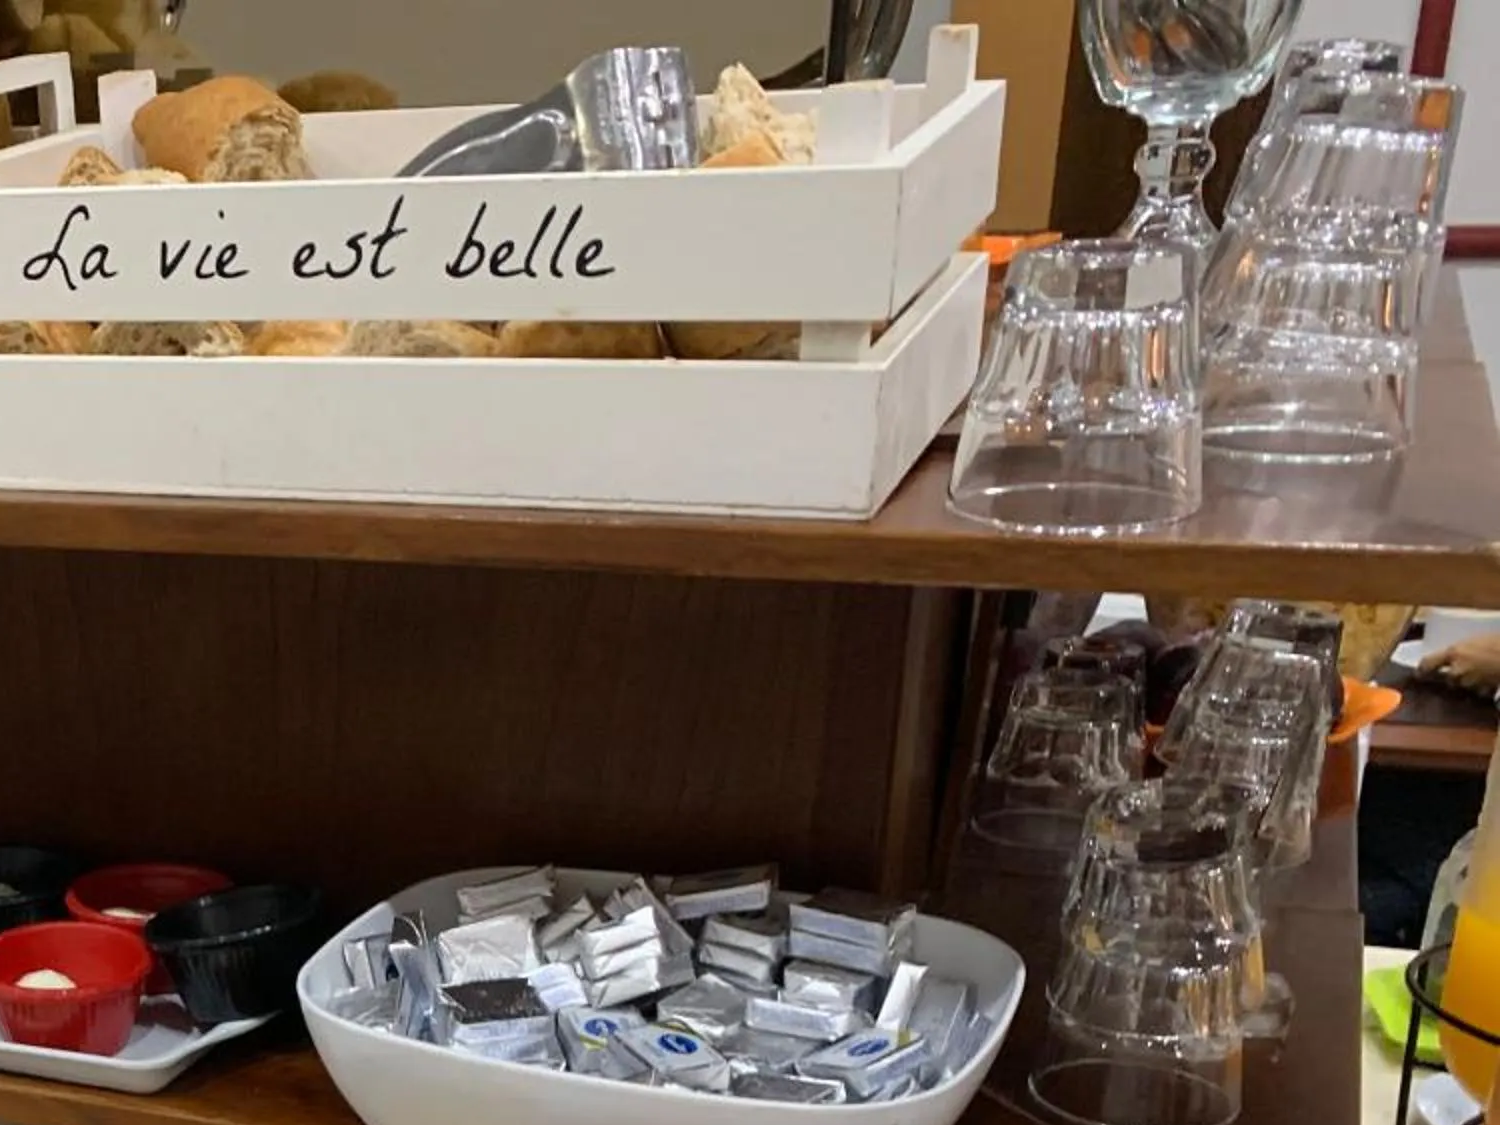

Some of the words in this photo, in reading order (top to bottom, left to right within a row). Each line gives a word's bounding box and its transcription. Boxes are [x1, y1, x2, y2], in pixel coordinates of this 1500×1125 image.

[22, 203, 118, 291] La
[159, 209, 250, 279] vie
[291, 195, 408, 279] est
[445, 201, 617, 279] belle
